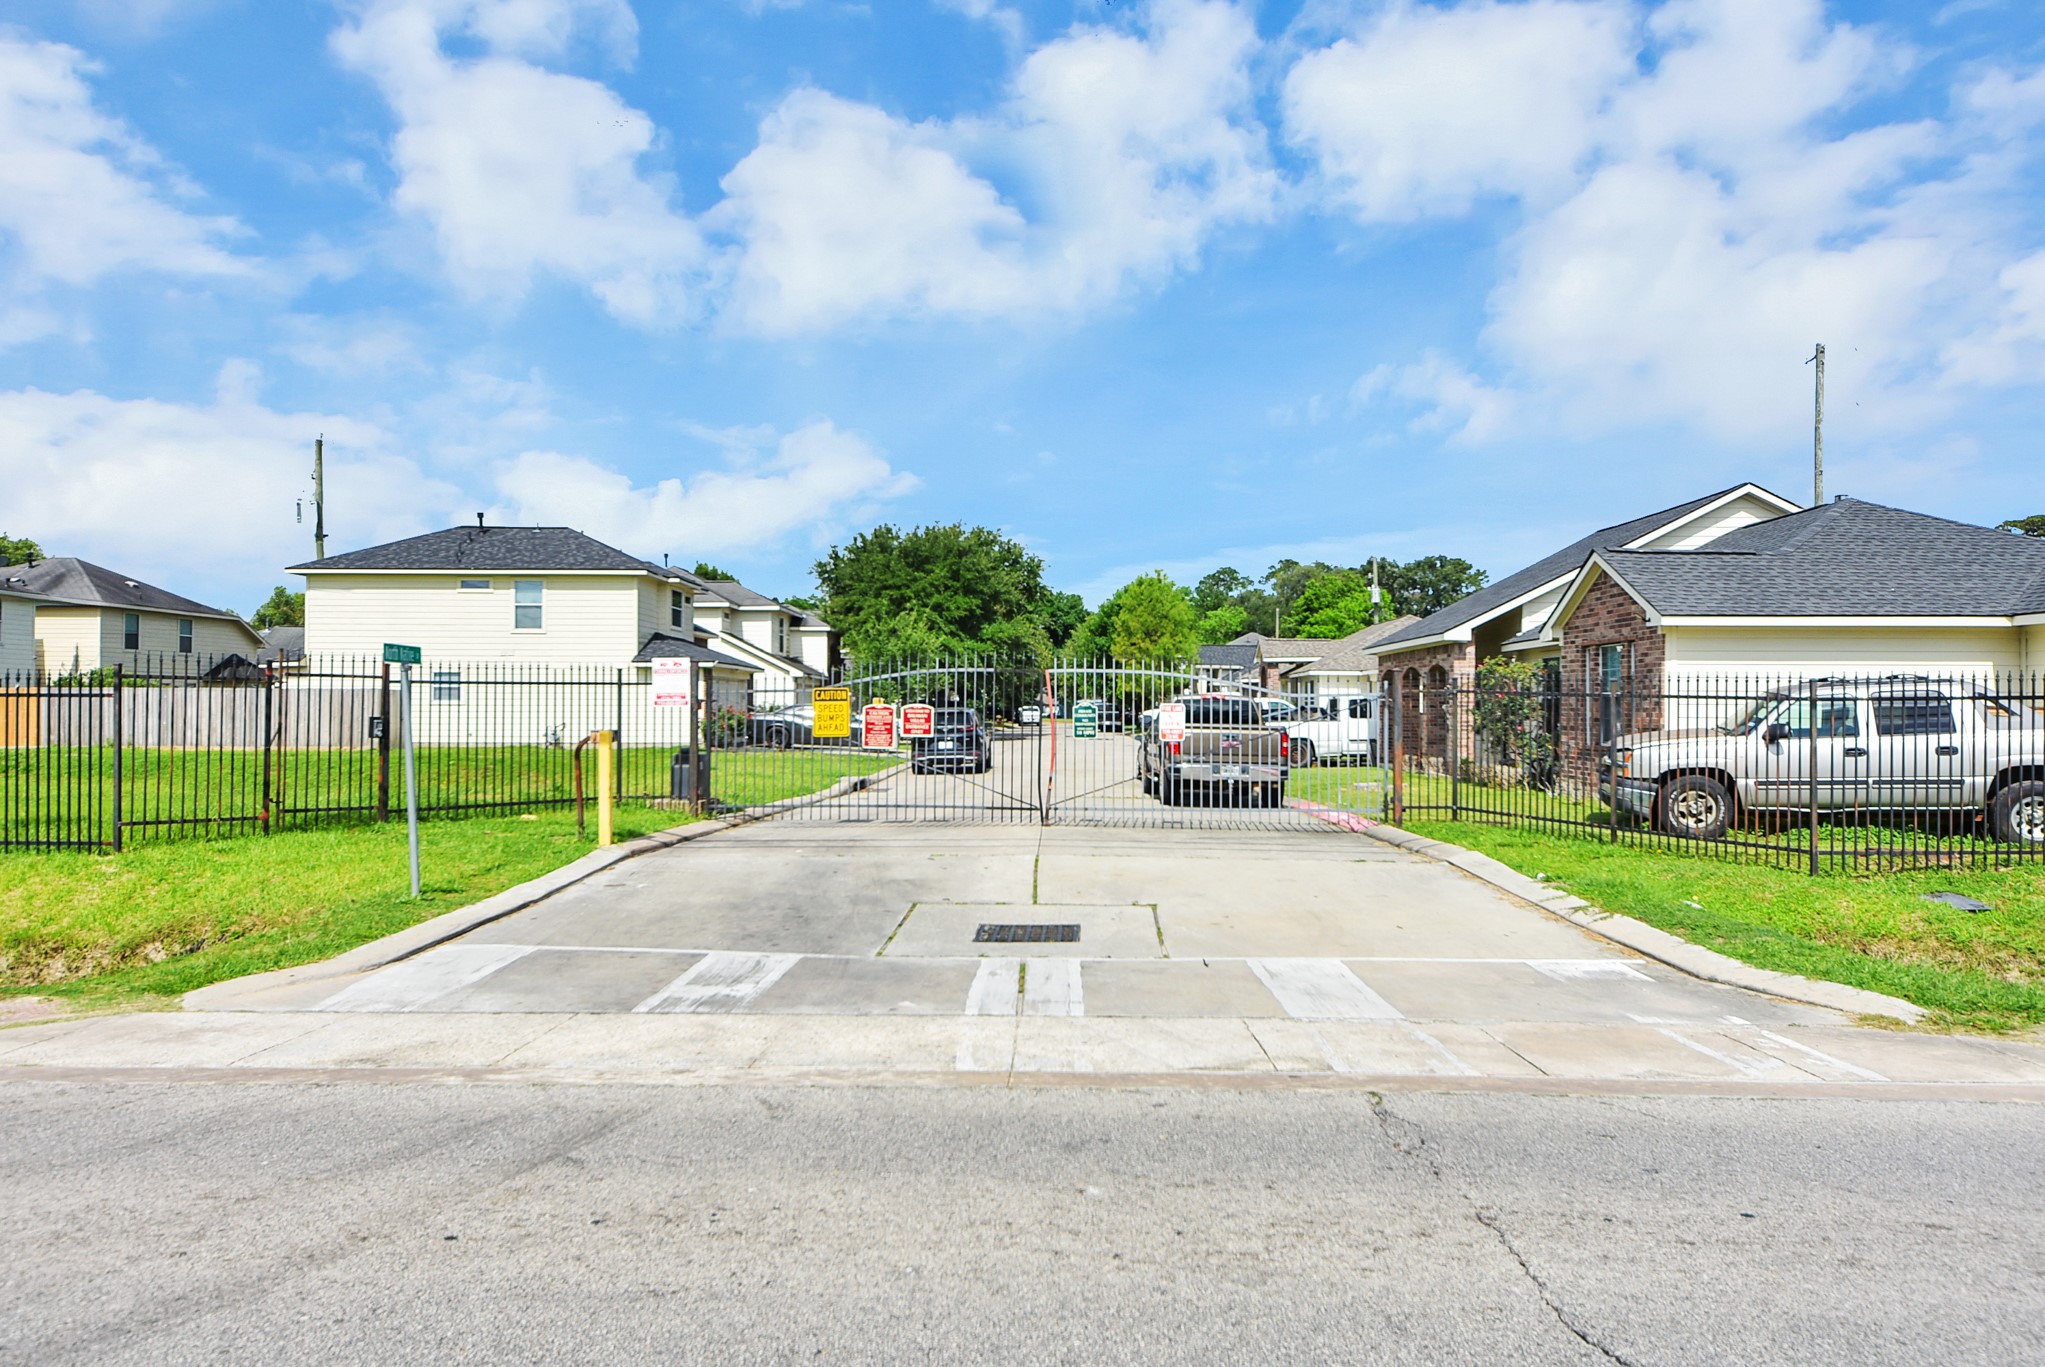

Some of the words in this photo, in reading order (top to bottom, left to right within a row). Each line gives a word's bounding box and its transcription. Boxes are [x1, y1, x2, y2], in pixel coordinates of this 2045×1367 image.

[815, 690, 847, 700] CAUTION
[818, 704, 844, 713] SPEED
[817, 713, 845, 723] BUMPS
[817, 723, 845, 732] AHEAD
